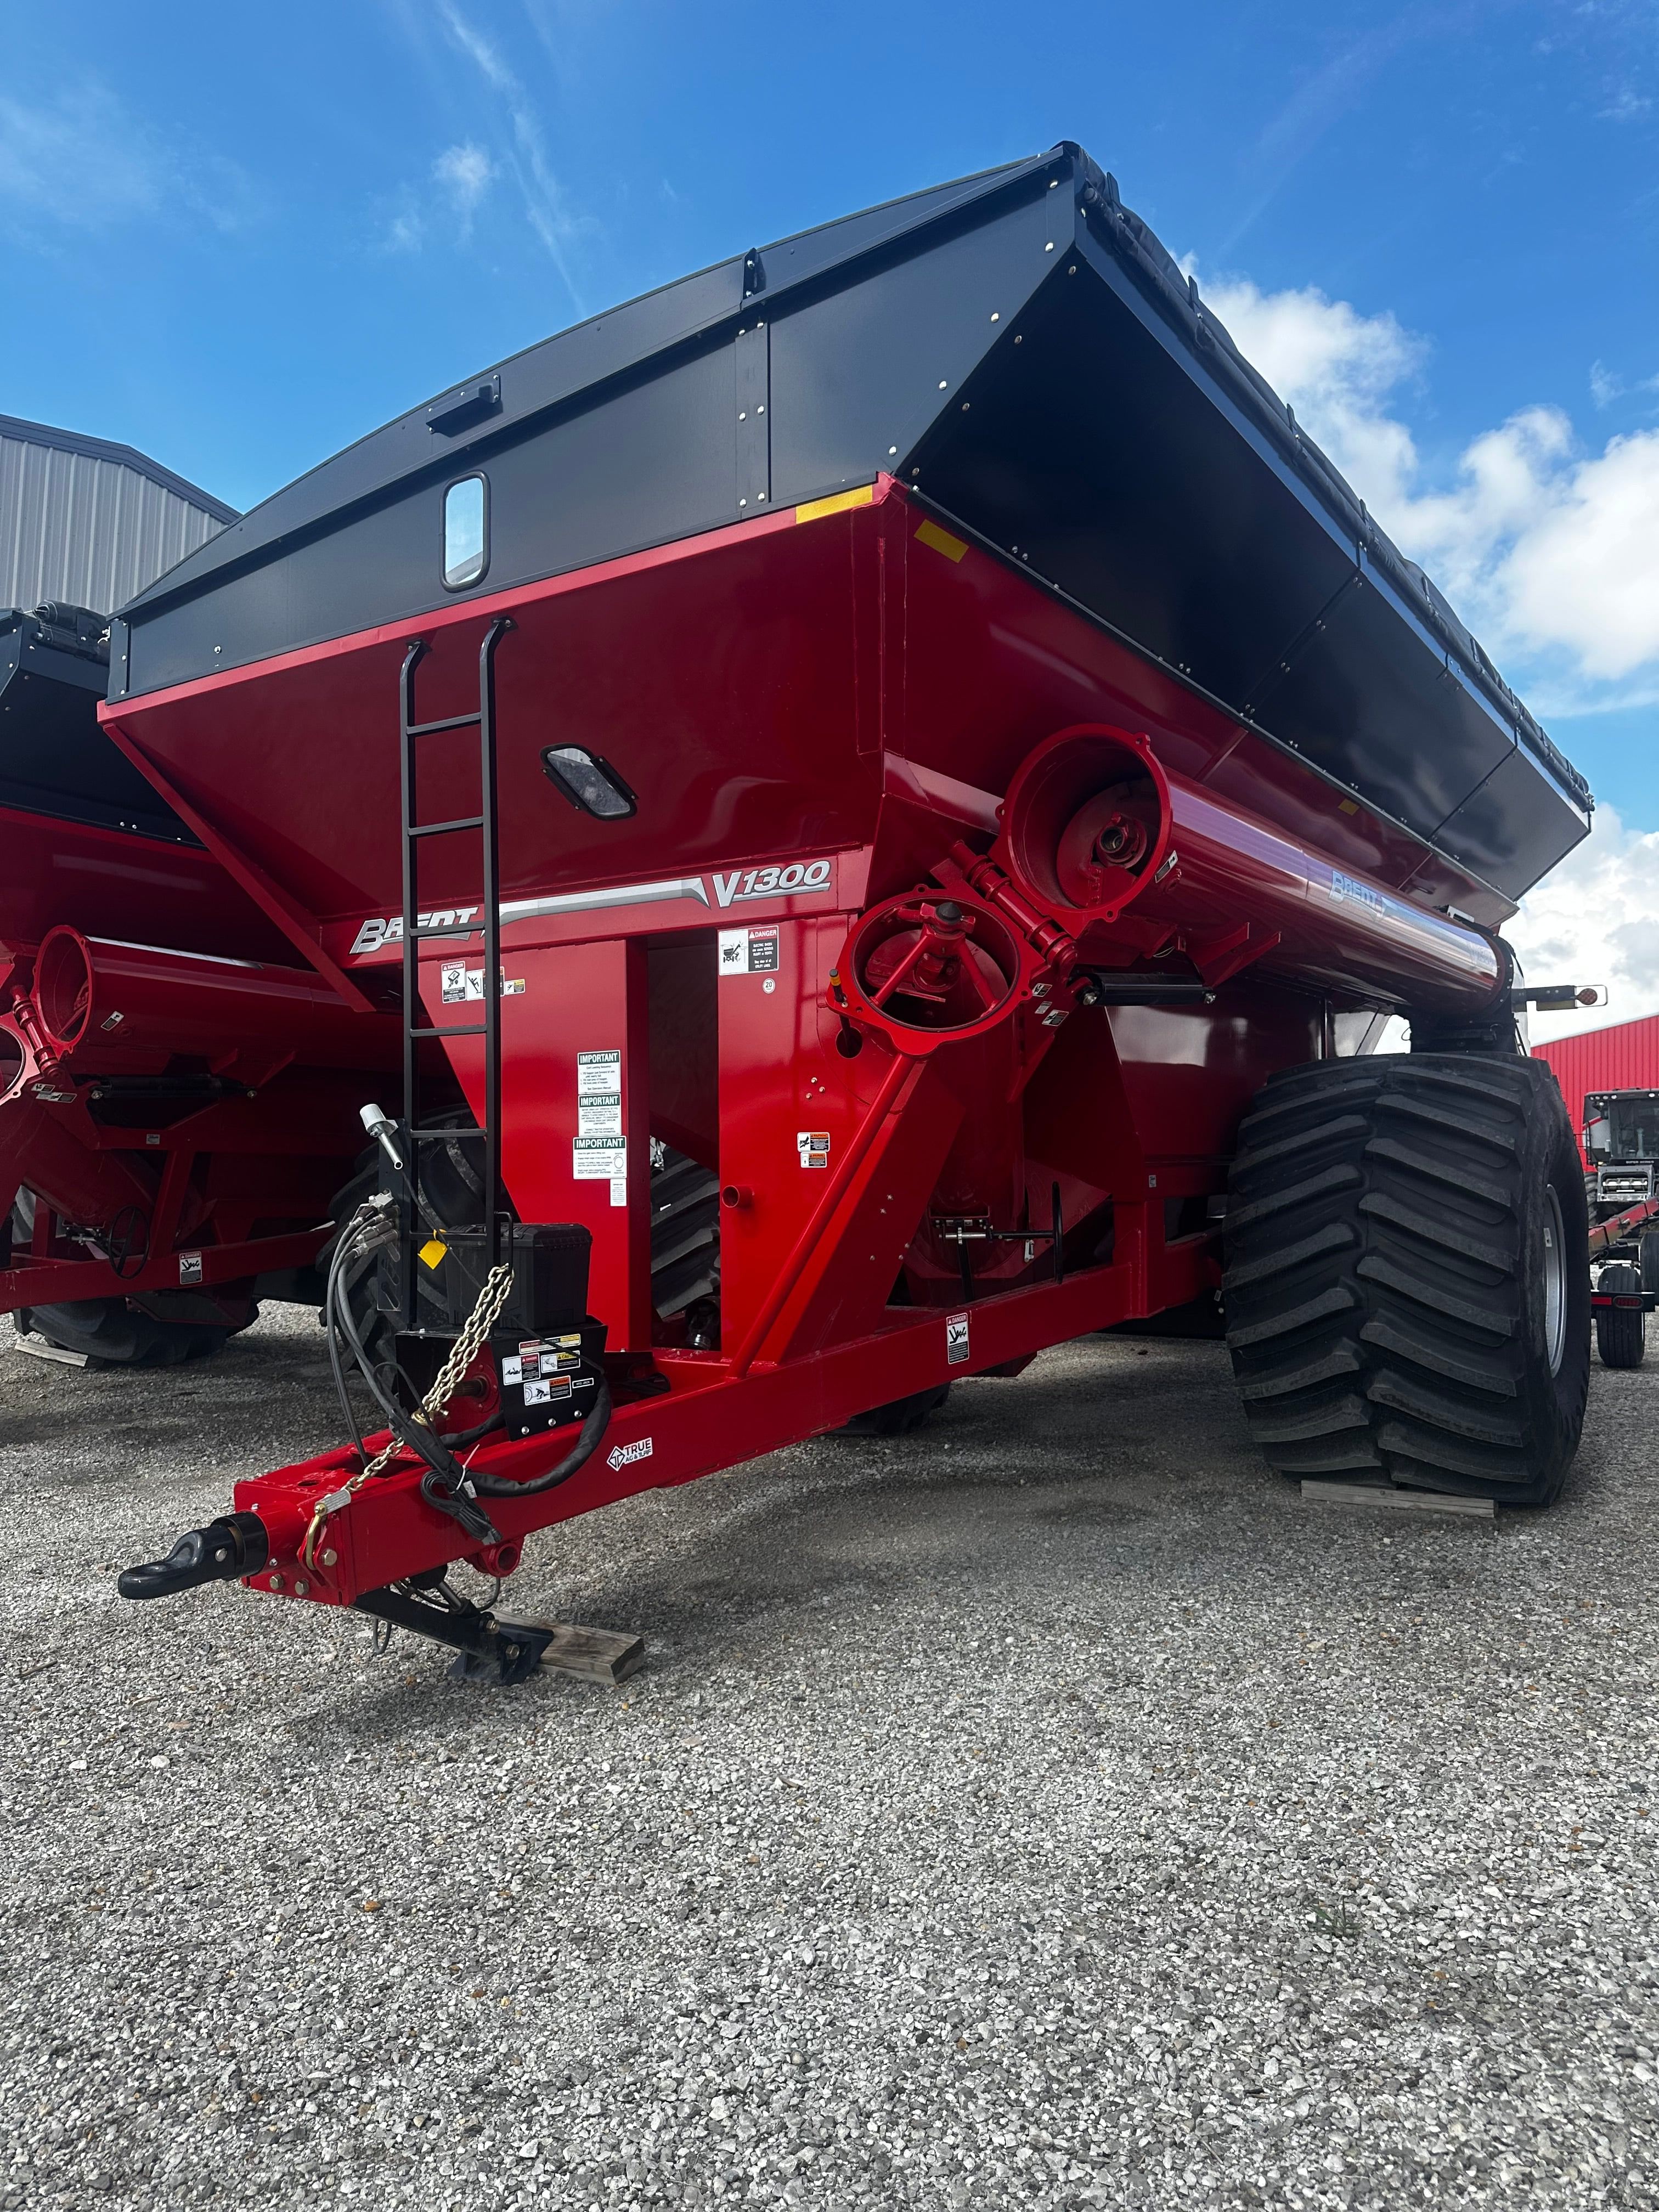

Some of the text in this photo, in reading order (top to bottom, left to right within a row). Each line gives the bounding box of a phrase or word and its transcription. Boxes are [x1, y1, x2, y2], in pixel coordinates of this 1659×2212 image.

[712, 860, 831, 908] V1300
[1329, 870, 1378, 910] BRENT
[755, 929, 777, 938] DANGER
[580, 1053, 618, 1064] IMPORTANT
[580, 1096, 619, 1106] IMPORTANT
[576, 1138, 624, 1148] IMPORTANT
[952, 1314, 966, 1324] DANGER
[624, 1439, 651, 1456] TRUE
